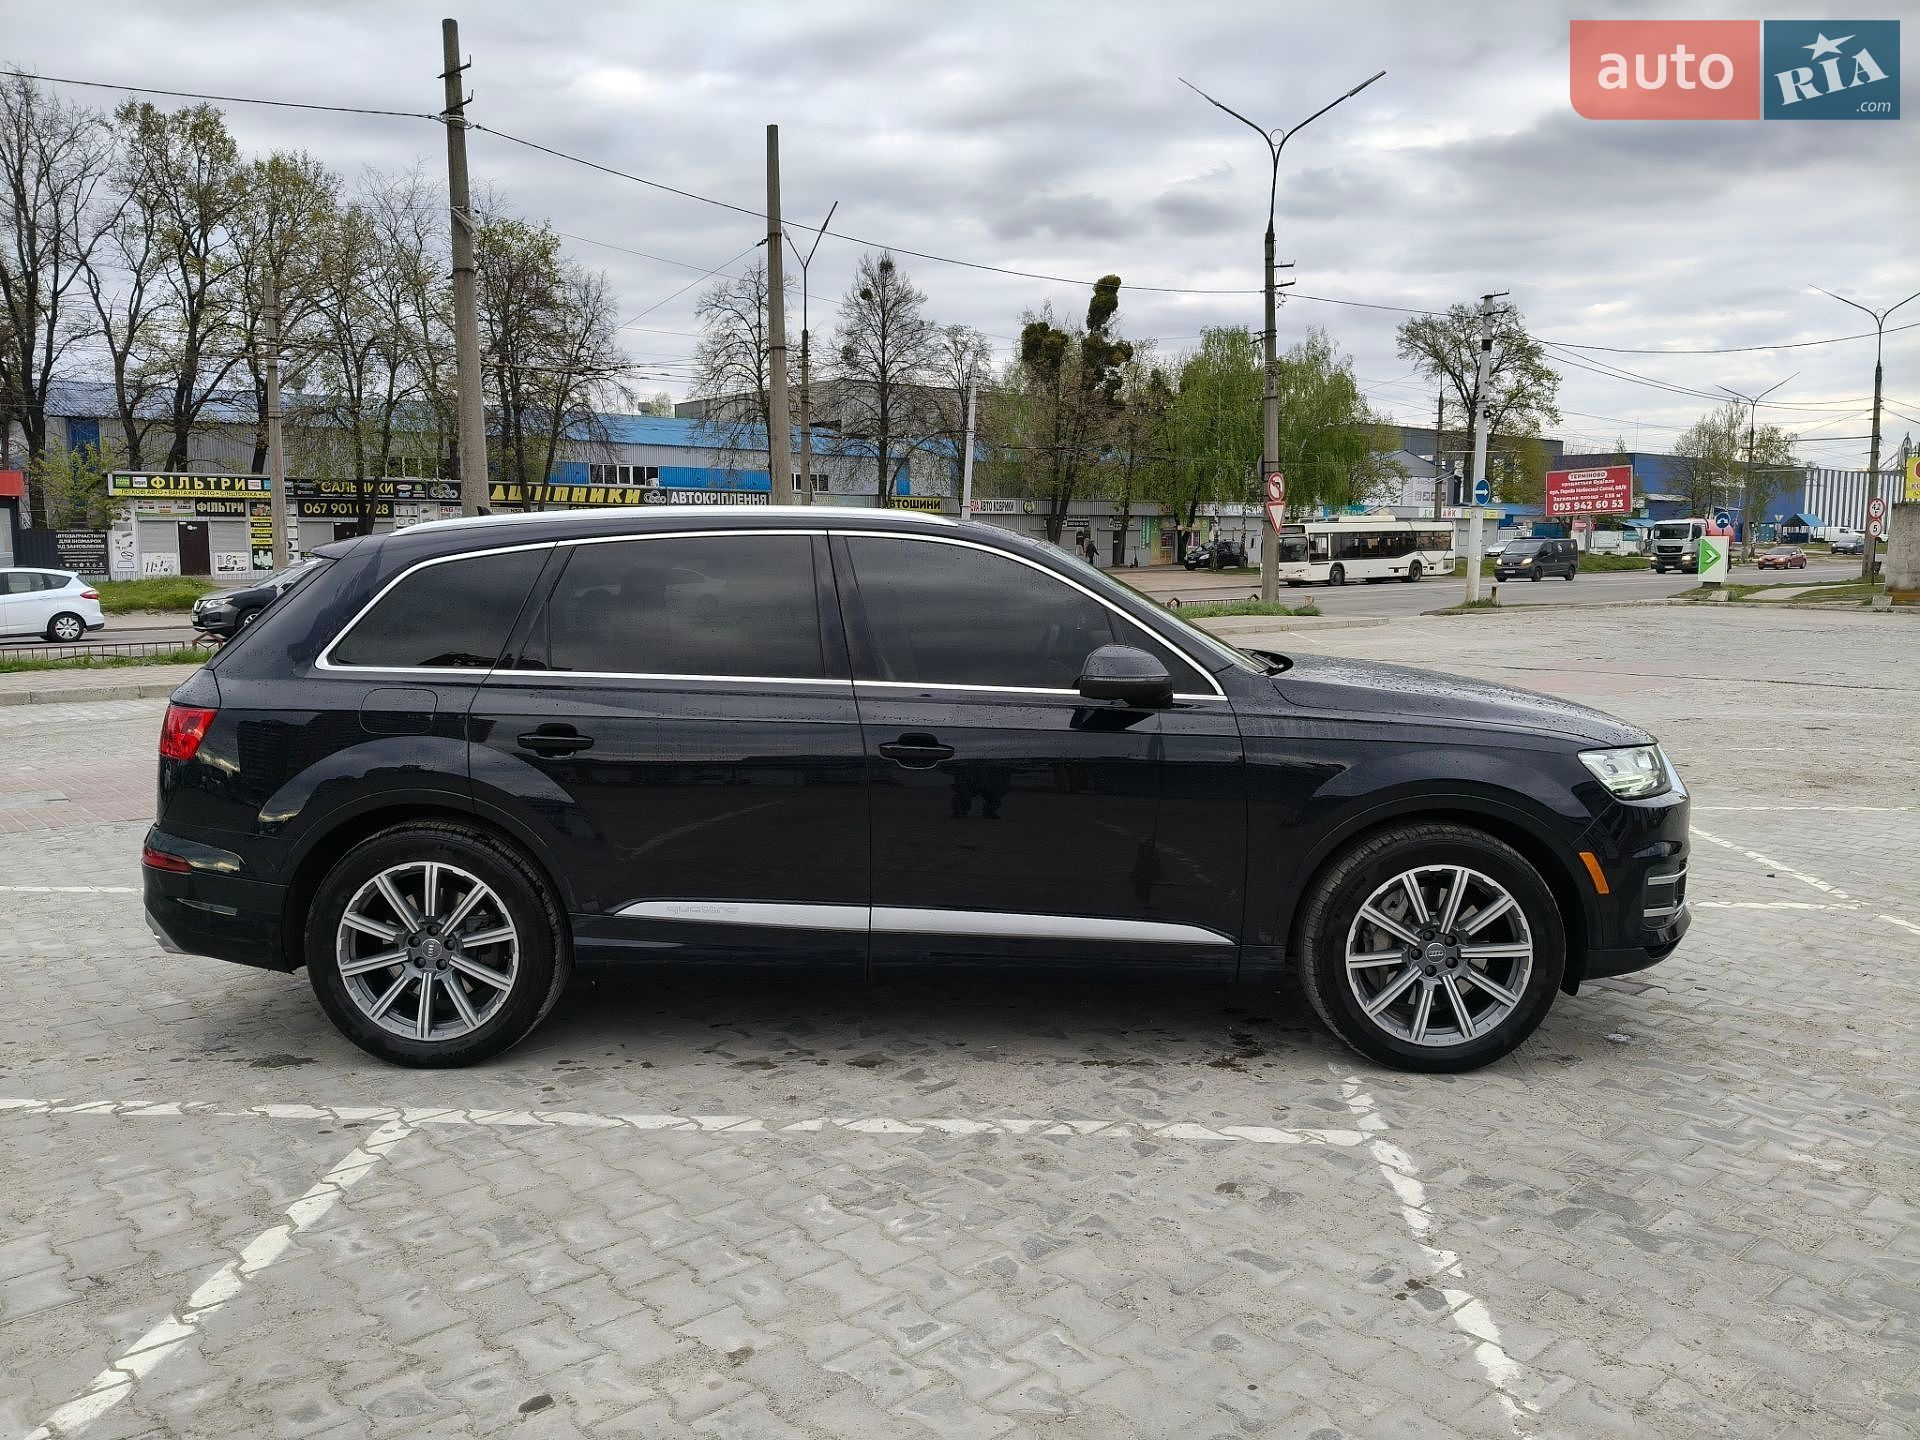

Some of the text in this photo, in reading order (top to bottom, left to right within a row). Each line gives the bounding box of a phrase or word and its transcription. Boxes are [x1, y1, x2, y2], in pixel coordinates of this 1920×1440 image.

[1570, 472, 1606, 480] ТЕРМІНОВО
[150, 475, 247, 491] ФІЛЬТРИ
[321, 481, 395, 494] САЛЬИКИ
[670, 491, 768, 505] АВТОКРІПЛЕННЯ
[889, 498, 941, 510] ВТОШИНИ
[196, 501, 245, 514] ФІЛЬТРИ
[303, 502, 327, 514] 067
[330, 502, 352, 514] 901
[1552, 499, 1624, 511] 093 942 60 53
[1872, 524, 1878, 532] 5
